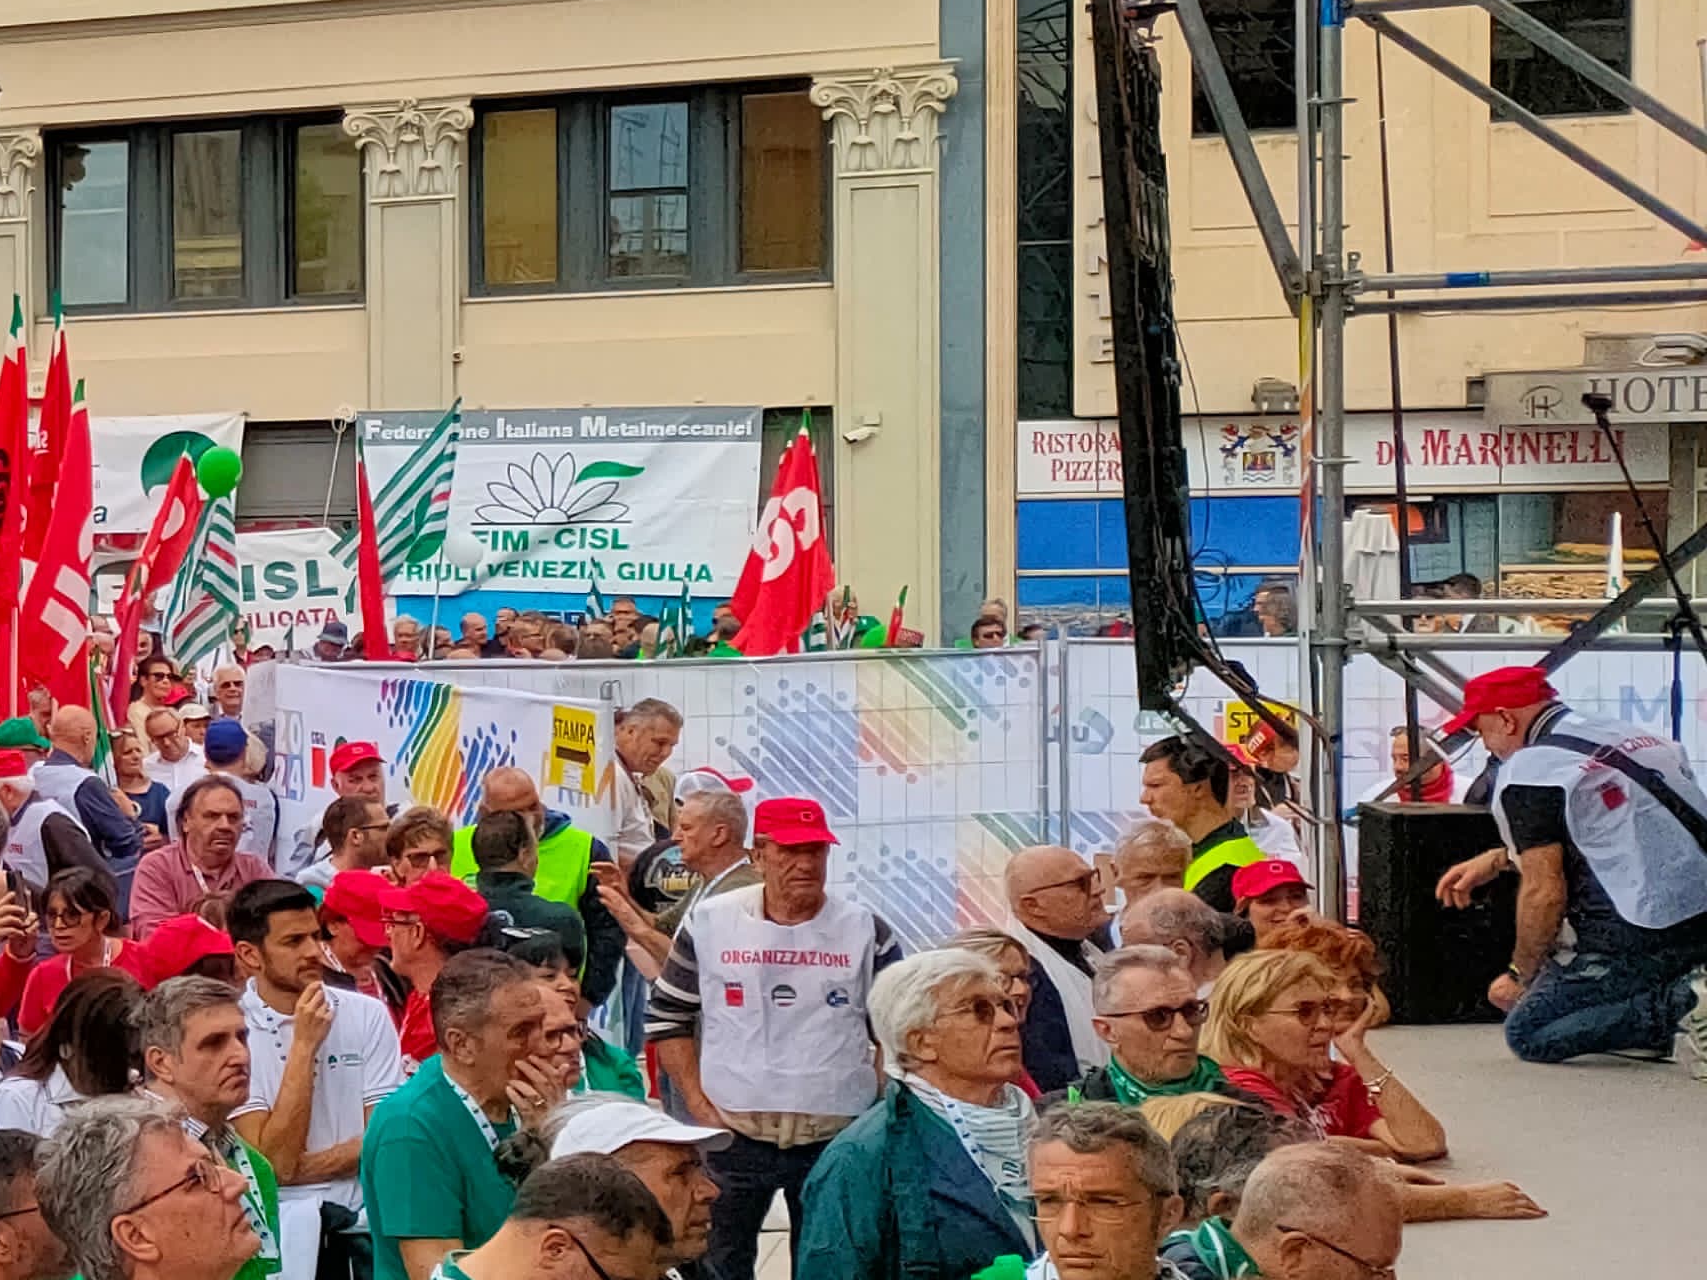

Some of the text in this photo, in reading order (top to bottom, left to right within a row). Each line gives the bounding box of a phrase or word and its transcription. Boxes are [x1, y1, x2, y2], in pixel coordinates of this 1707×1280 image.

[365, 416, 752, 440] Federaone Italiana Metalmeccanici
[553, 527, 630, 552] CISL
[486, 559, 605, 581] VENEZIA
[618, 560, 713, 582] GIULIA
[553, 717, 596, 743] STAMPA
[720, 949, 852, 968] ORGANIZZAZIONE
